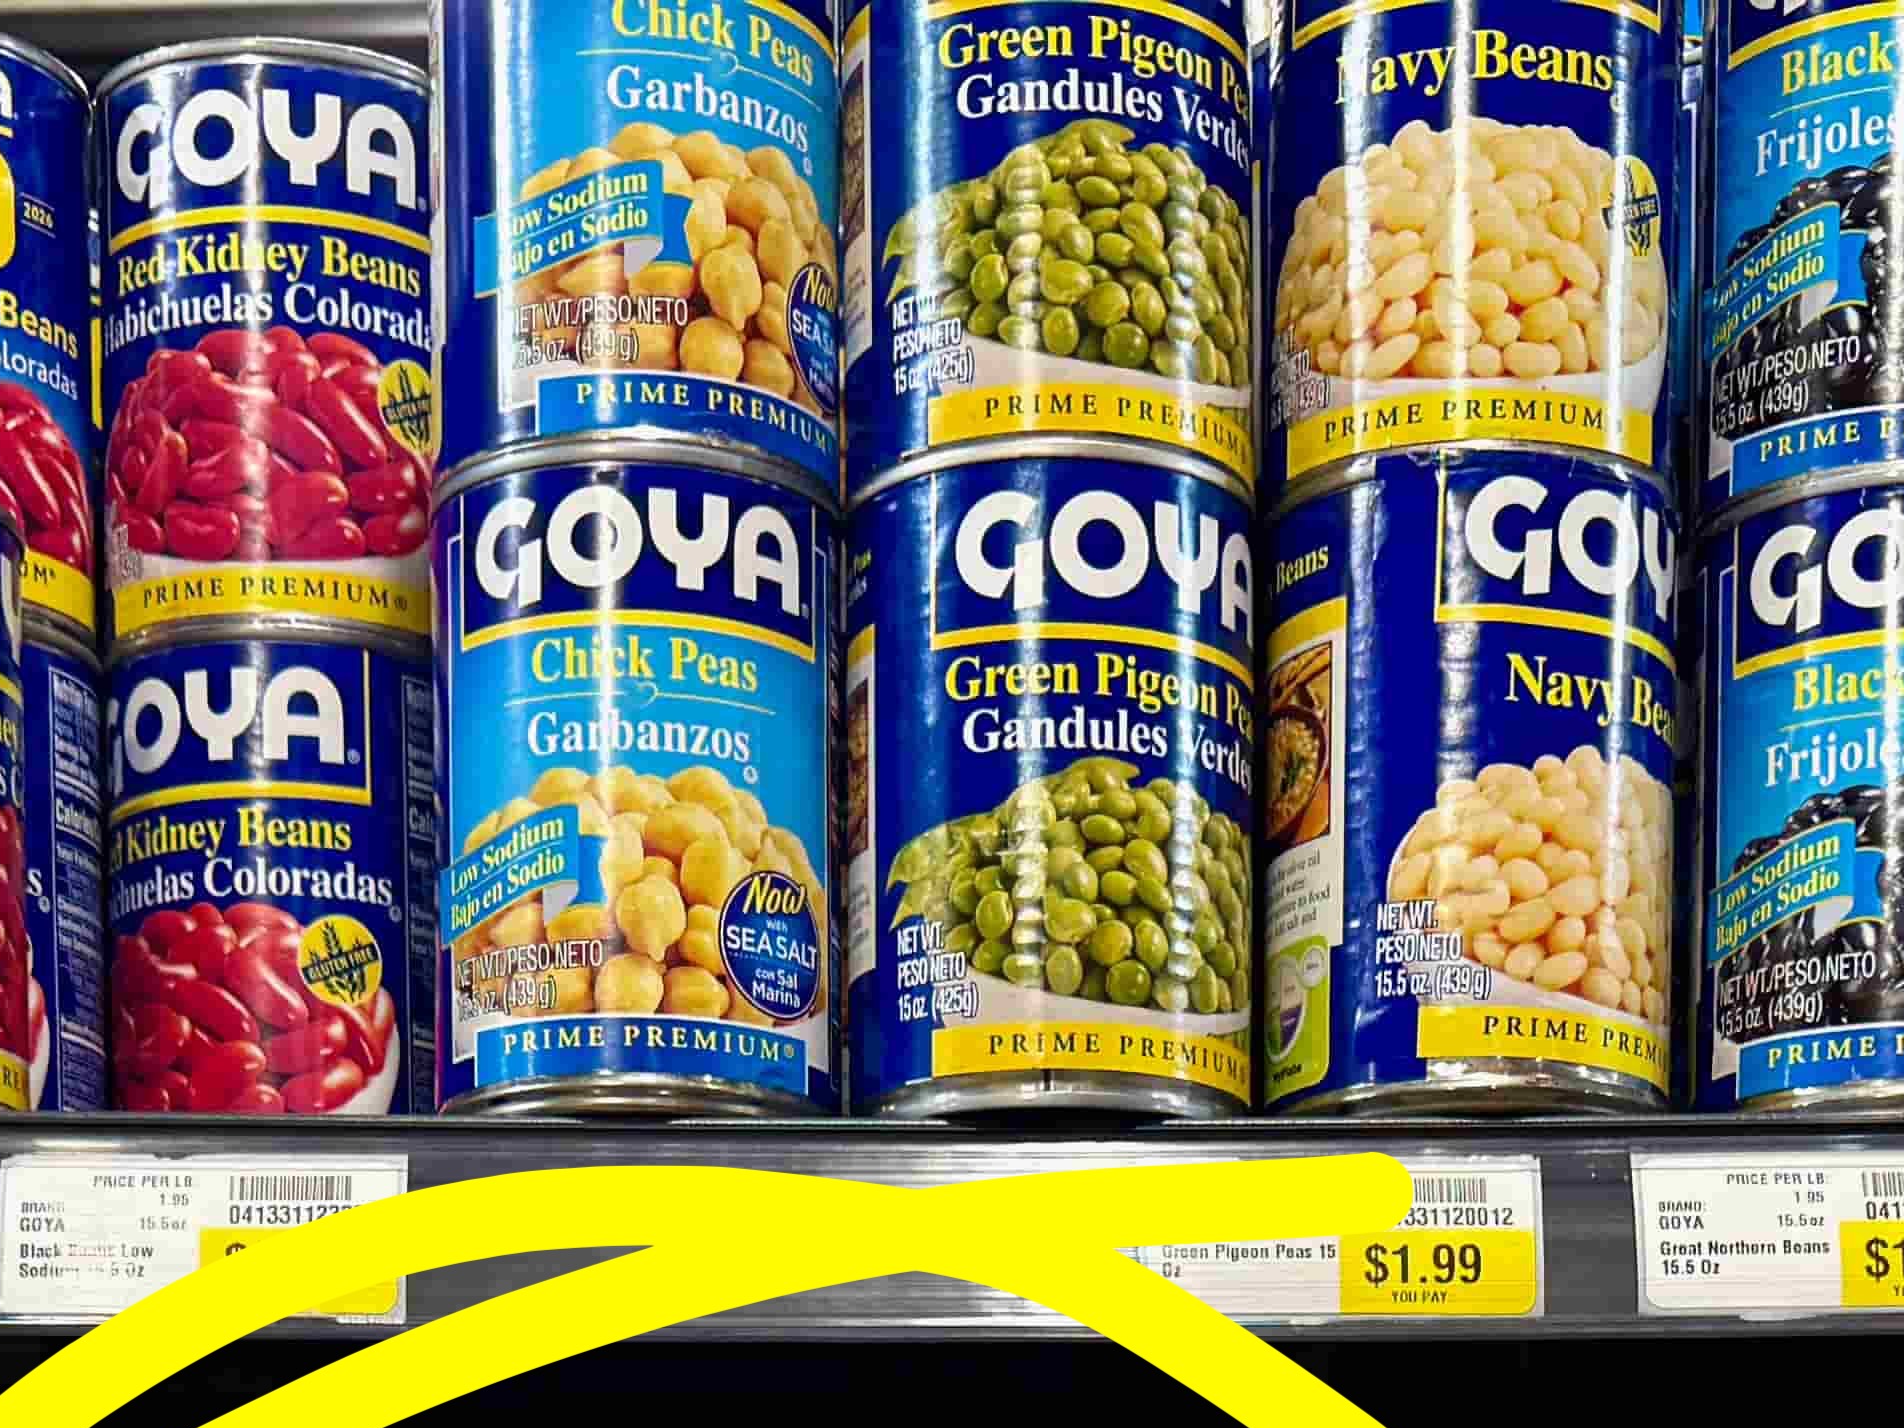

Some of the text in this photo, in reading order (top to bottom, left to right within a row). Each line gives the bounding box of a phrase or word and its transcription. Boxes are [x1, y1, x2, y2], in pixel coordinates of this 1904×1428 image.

[956, 70, 1166, 122] Gandules
[1780, 39, 1894, 96] Black
[606, 63, 811, 153] Garbanzos
[116, 88, 418, 209] GOYA
[1755, 109, 1903, 177] Frijoles
[201, 856, 393, 907] Coloradas
[450, 814, 566, 897] Low Sodium
[1363, 1242, 1484, 1290] $1.99
[1660, 1240, 1831, 1256] Great Northern Beans
